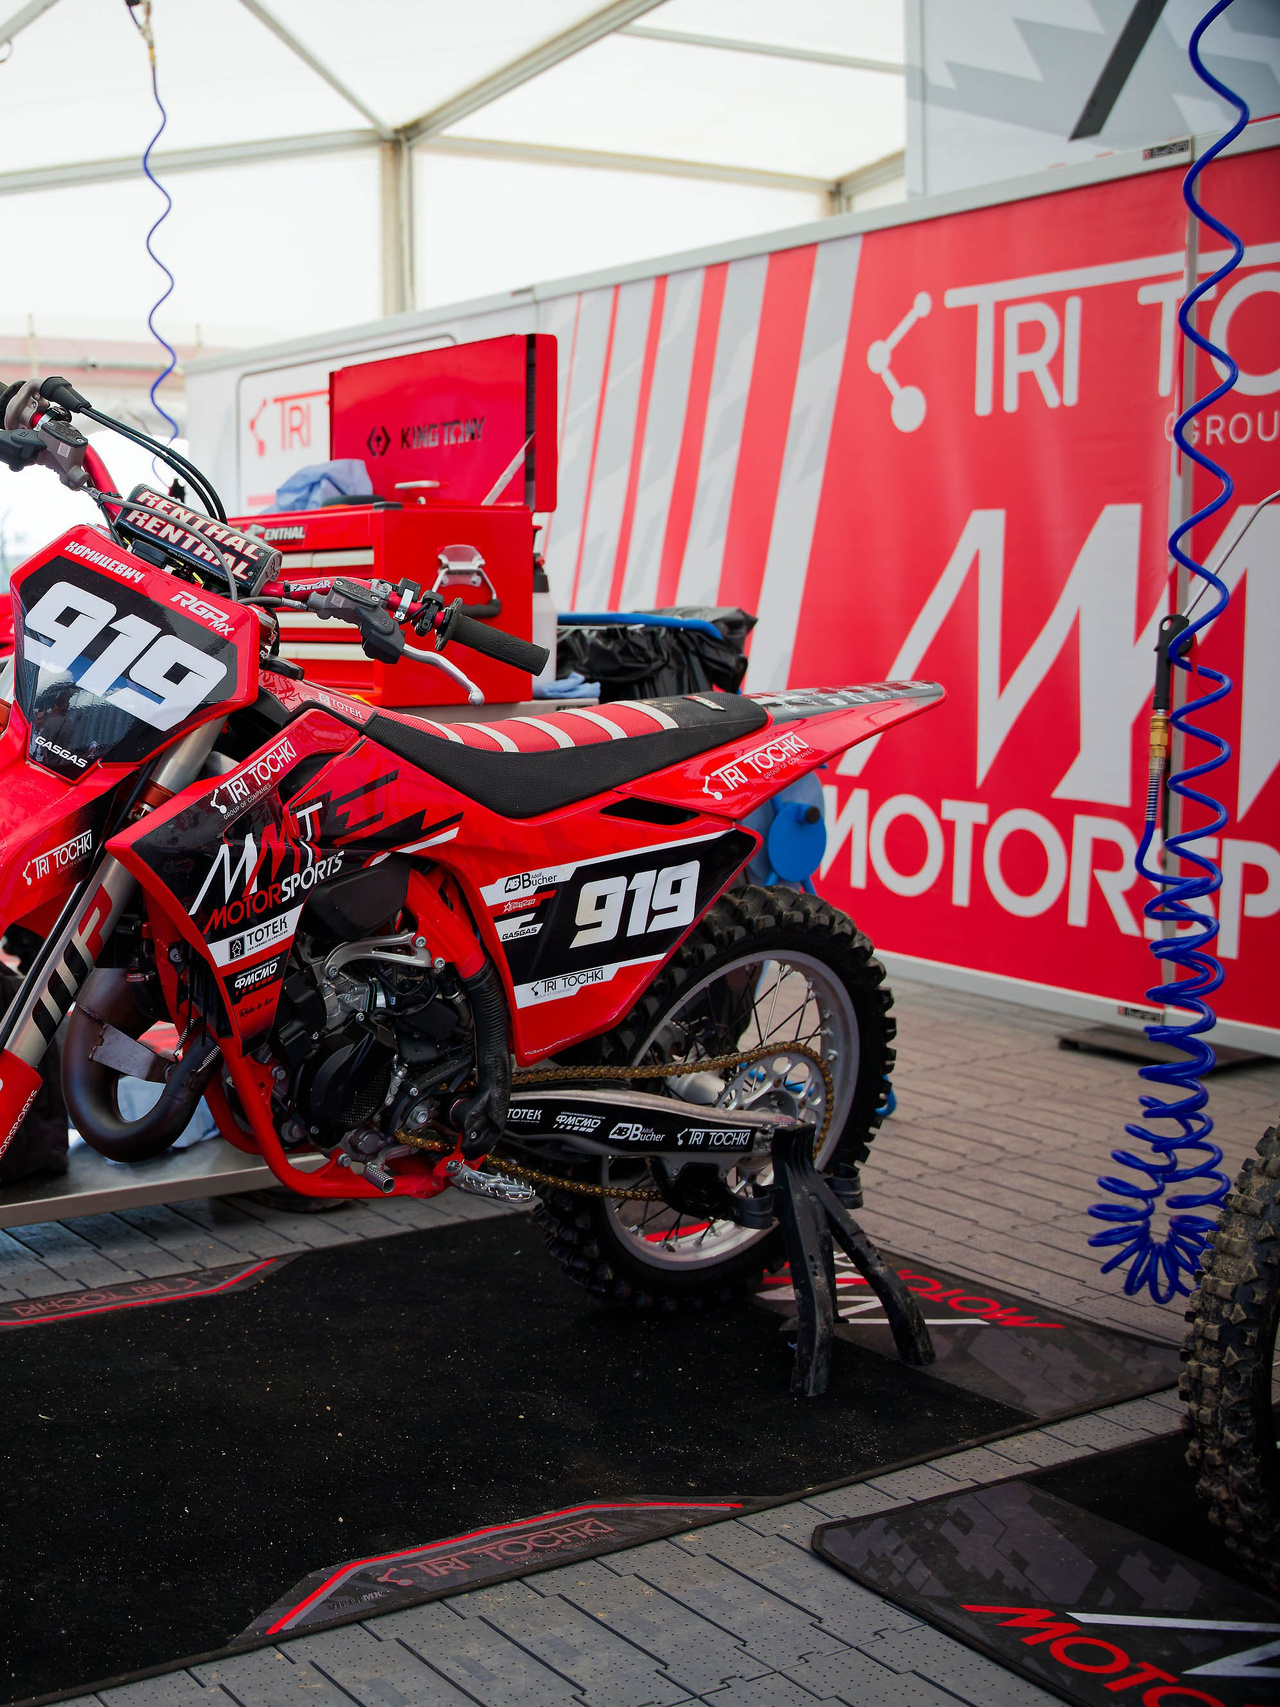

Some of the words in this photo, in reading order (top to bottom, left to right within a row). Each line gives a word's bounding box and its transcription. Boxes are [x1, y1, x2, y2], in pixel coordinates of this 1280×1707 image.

[944, 286, 1082, 417] TRI
[401, 424, 439, 449] KING
[64, 541, 146, 584] ХОМИЦЕВИЧ
[24, 581, 228, 732] 919
[331, 698, 363, 720] TOTEK
[34, 735, 88, 768] GASGAS
[711, 766, 748, 790] TRI
[743, 734, 809, 774] TOCHKI
[220, 777, 250, 804] TRI
[248, 740, 297, 786] TOCHKI
[763, 767, 780, 779] GROUP
[223, 805, 240, 820] GROUP
[247, 782, 272, 802] COMPANIES
[32, 856, 49, 879] TRI
[53, 833, 92, 868] TOCHKI
[202, 850, 345, 936] MOTORSPORTS
[521, 873, 557, 889] Bucher
[569, 860, 700, 949] 919
[246, 916, 288, 945] TOTEK
[502, 927, 537, 940] GASGAS
[541, 979, 556, 993] TRI
[561, 969, 604, 988] TOCHKI
[507, 1108, 542, 1121] TOTEK
[688, 1129, 702, 1146] TRI
[708, 1131, 751, 1146] TOCHKI
[402, 1556, 471, 1577] TRI
[474, 1520, 615, 1561] TOCHKI
